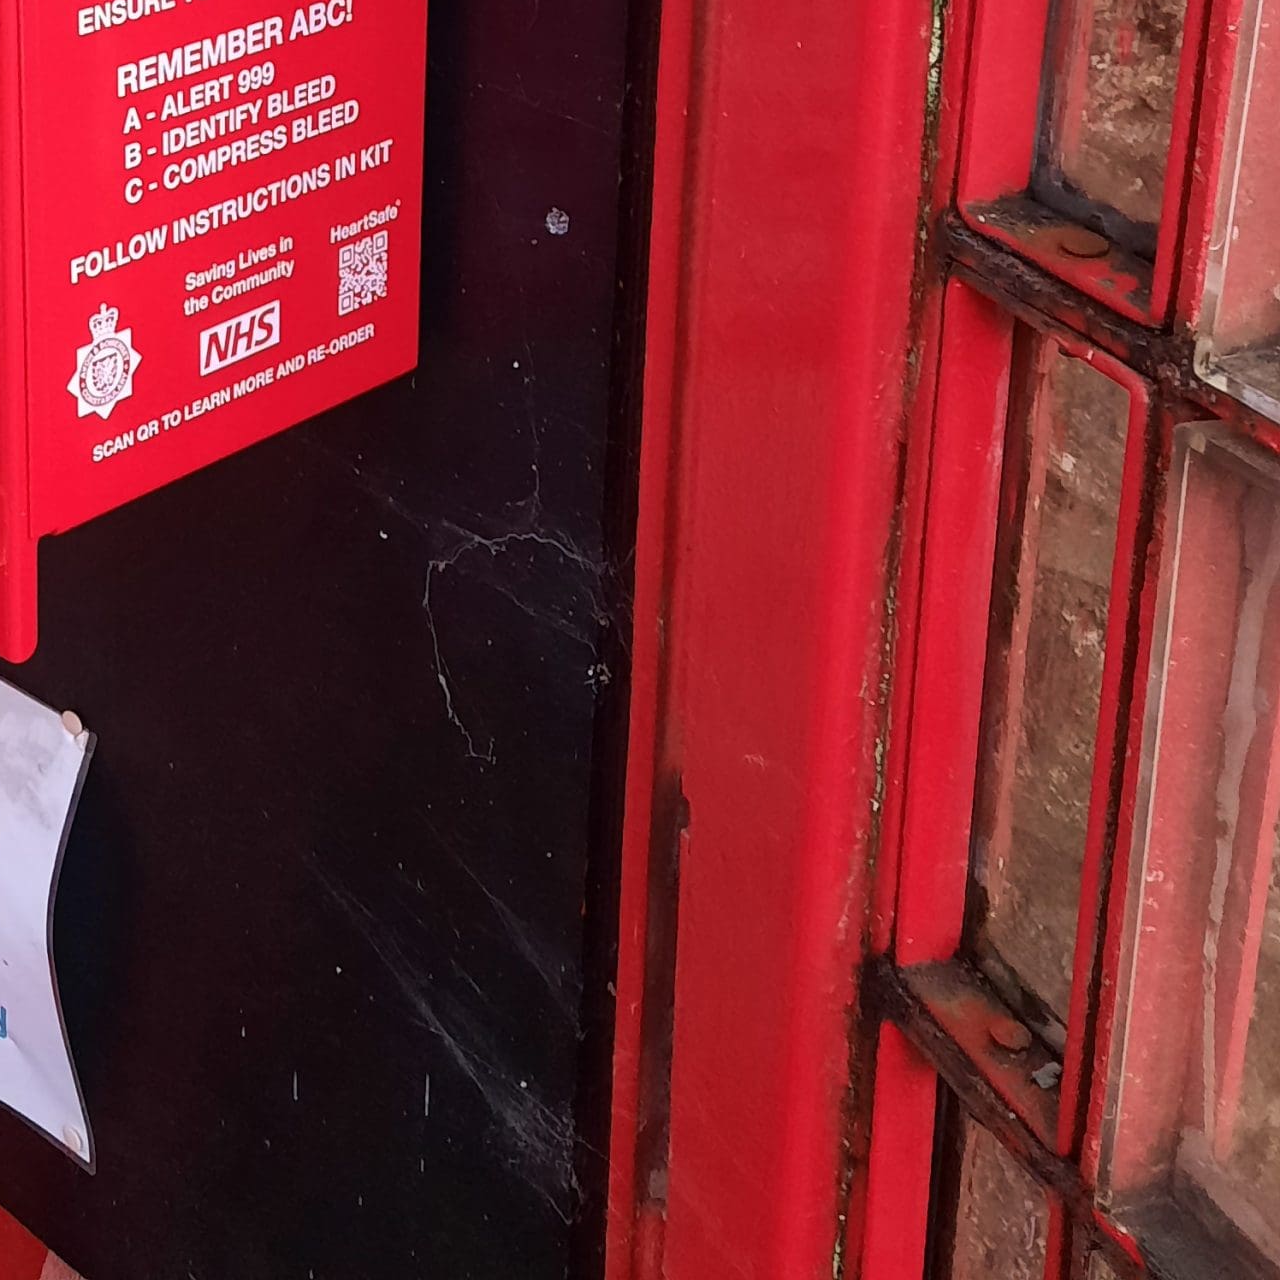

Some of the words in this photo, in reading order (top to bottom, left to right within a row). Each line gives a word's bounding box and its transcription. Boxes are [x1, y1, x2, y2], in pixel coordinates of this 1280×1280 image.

[117, 16, 283, 97] REMEMBER
[123, 106, 141, 134] A
[160, 73, 234, 121] ALERT
[237, 61, 276, 95] 999
[124, 142, 142, 170] B
[162, 100, 260, 157] IDENTIFY
[267, 73, 336, 118] BLEED
[124, 177, 144, 205] C
[163, 124, 288, 191] COMPRESS
[291, 99, 360, 142] BLEED
[69, 223, 167, 285] FOLLOW
[173, 164, 331, 244] INSTRUCTIONS
[335, 153, 356, 181] IN
[360, 139, 393, 174] KIT
[184, 295, 209, 316] the
[212, 260, 294, 304] Community
[185, 260, 235, 291] Saving
[239, 243, 276, 269] Lives
[280, 236, 293, 253] in
[204, 307, 275, 370] NHS
[92, 430, 134, 463] SCAN
[137, 419, 159, 443] QR
[161, 410, 181, 432] TO
[184, 386, 230, 420] LEARN
[233, 367, 274, 399] MORE
[276, 354, 305, 380] AND
[307, 323, 375, 366] RE-ORDER
